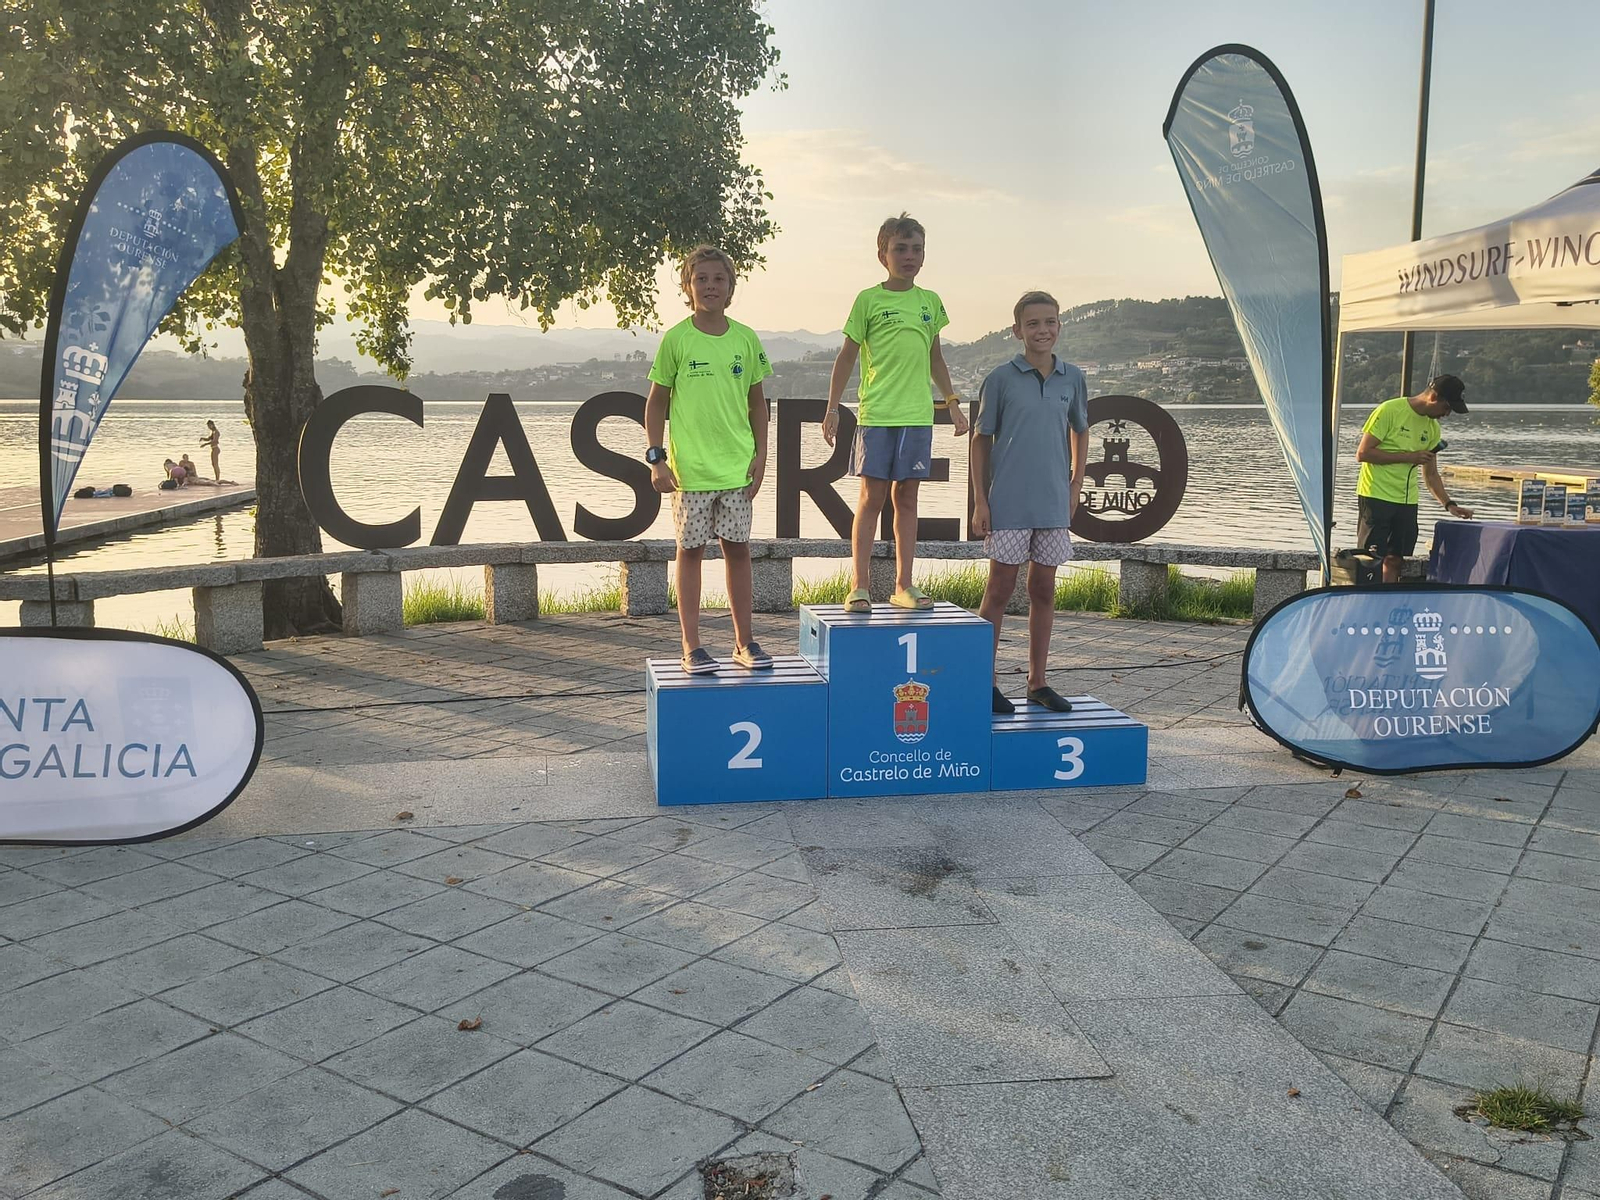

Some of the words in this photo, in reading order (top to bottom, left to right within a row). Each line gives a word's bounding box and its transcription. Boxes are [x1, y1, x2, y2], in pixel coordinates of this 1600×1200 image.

[110, 227, 179, 262] DEPUTACIÓN
[117, 242, 167, 269] OURENSE
[1103, 490, 1151, 510] MIÑO
[898, 632, 917, 674] 1
[1349, 682, 1511, 709] DEPUTACIÓN
[1373, 714, 1492, 737] OURENSE
[728, 721, 763, 770] 2
[869, 749, 931, 764] Concello
[935, 748, 952, 761] de
[1054, 736, 1085, 781] 3
[0, 743, 197, 779] GALICIA
[840, 764, 909, 782] Castrelo
[912, 764, 933, 779] de
[937, 762, 981, 779] Miño
